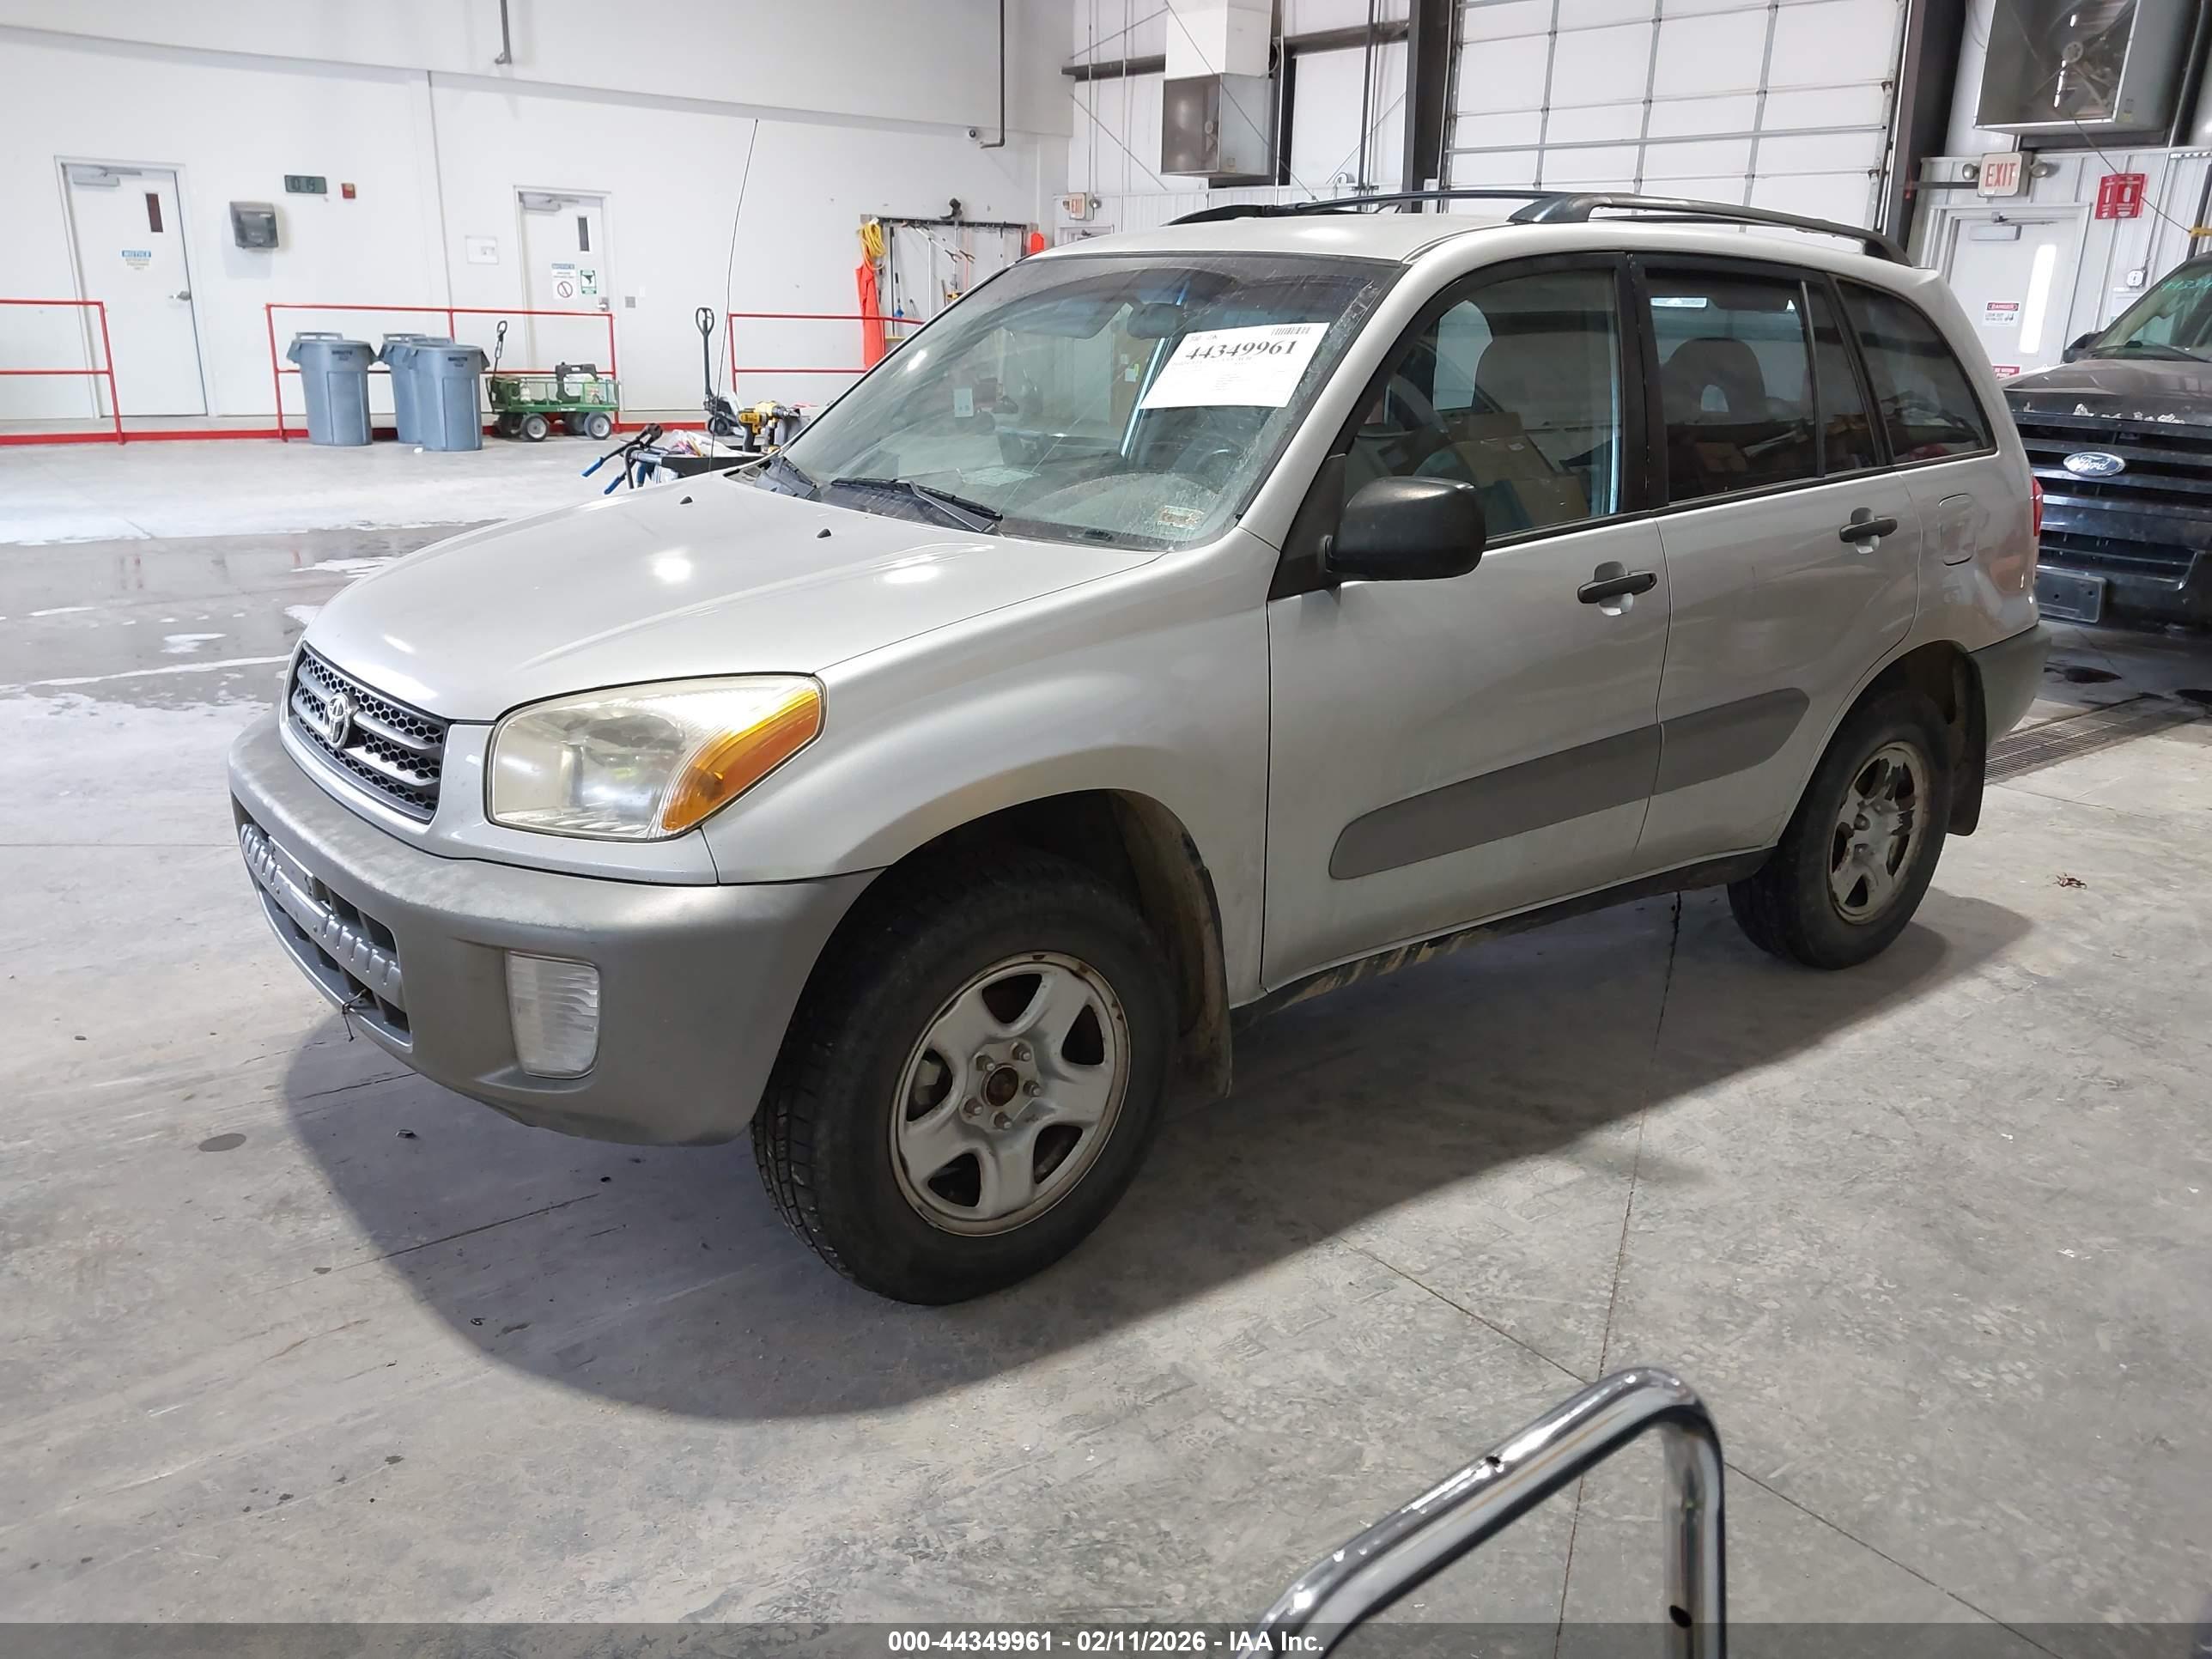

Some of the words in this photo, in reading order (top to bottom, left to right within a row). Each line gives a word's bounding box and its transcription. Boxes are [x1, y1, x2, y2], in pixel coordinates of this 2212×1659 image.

[1985, 163, 2016, 187] EXIT
[1186, 340, 1297, 360] 44349961
[2076, 455, 2111, 471] Ford
